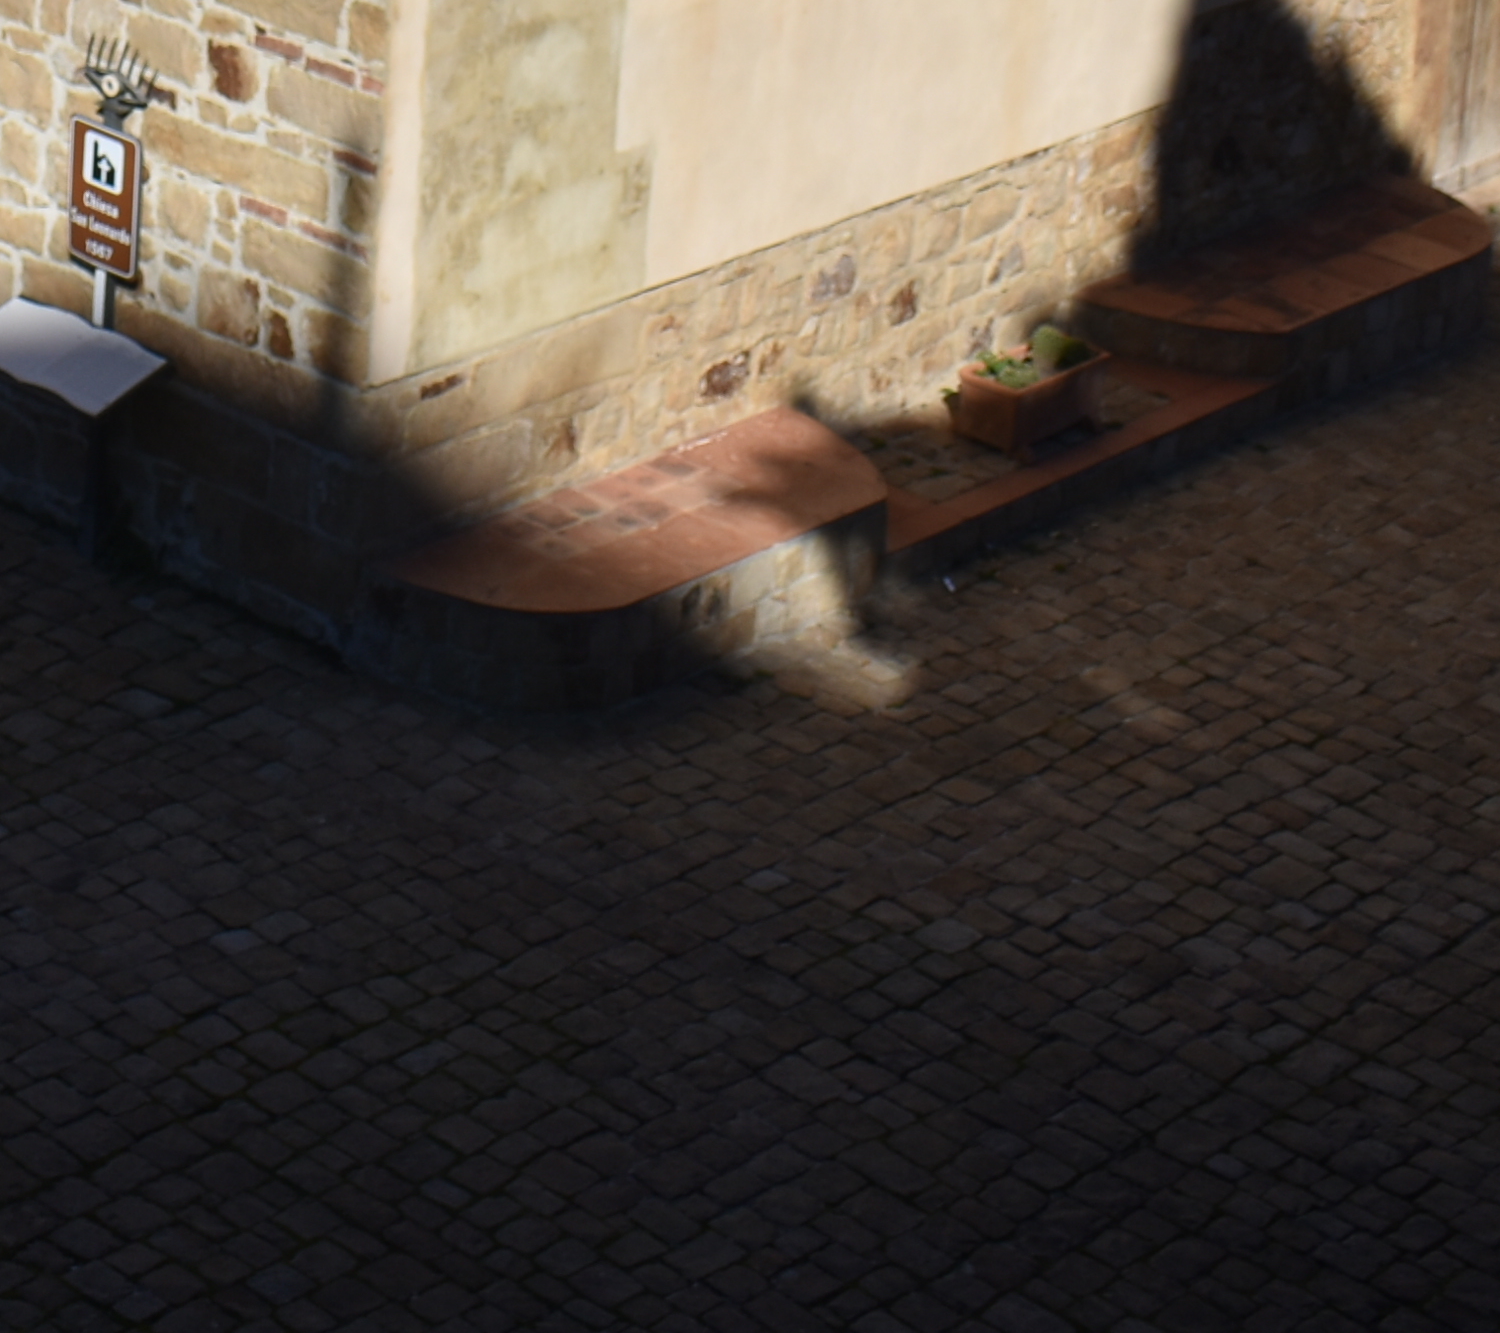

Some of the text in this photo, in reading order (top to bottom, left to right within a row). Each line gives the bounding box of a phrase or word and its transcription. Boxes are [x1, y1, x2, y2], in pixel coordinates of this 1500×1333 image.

[83, 190, 119, 219] Chiesa
[70, 206, 131, 246] San Leonardo
